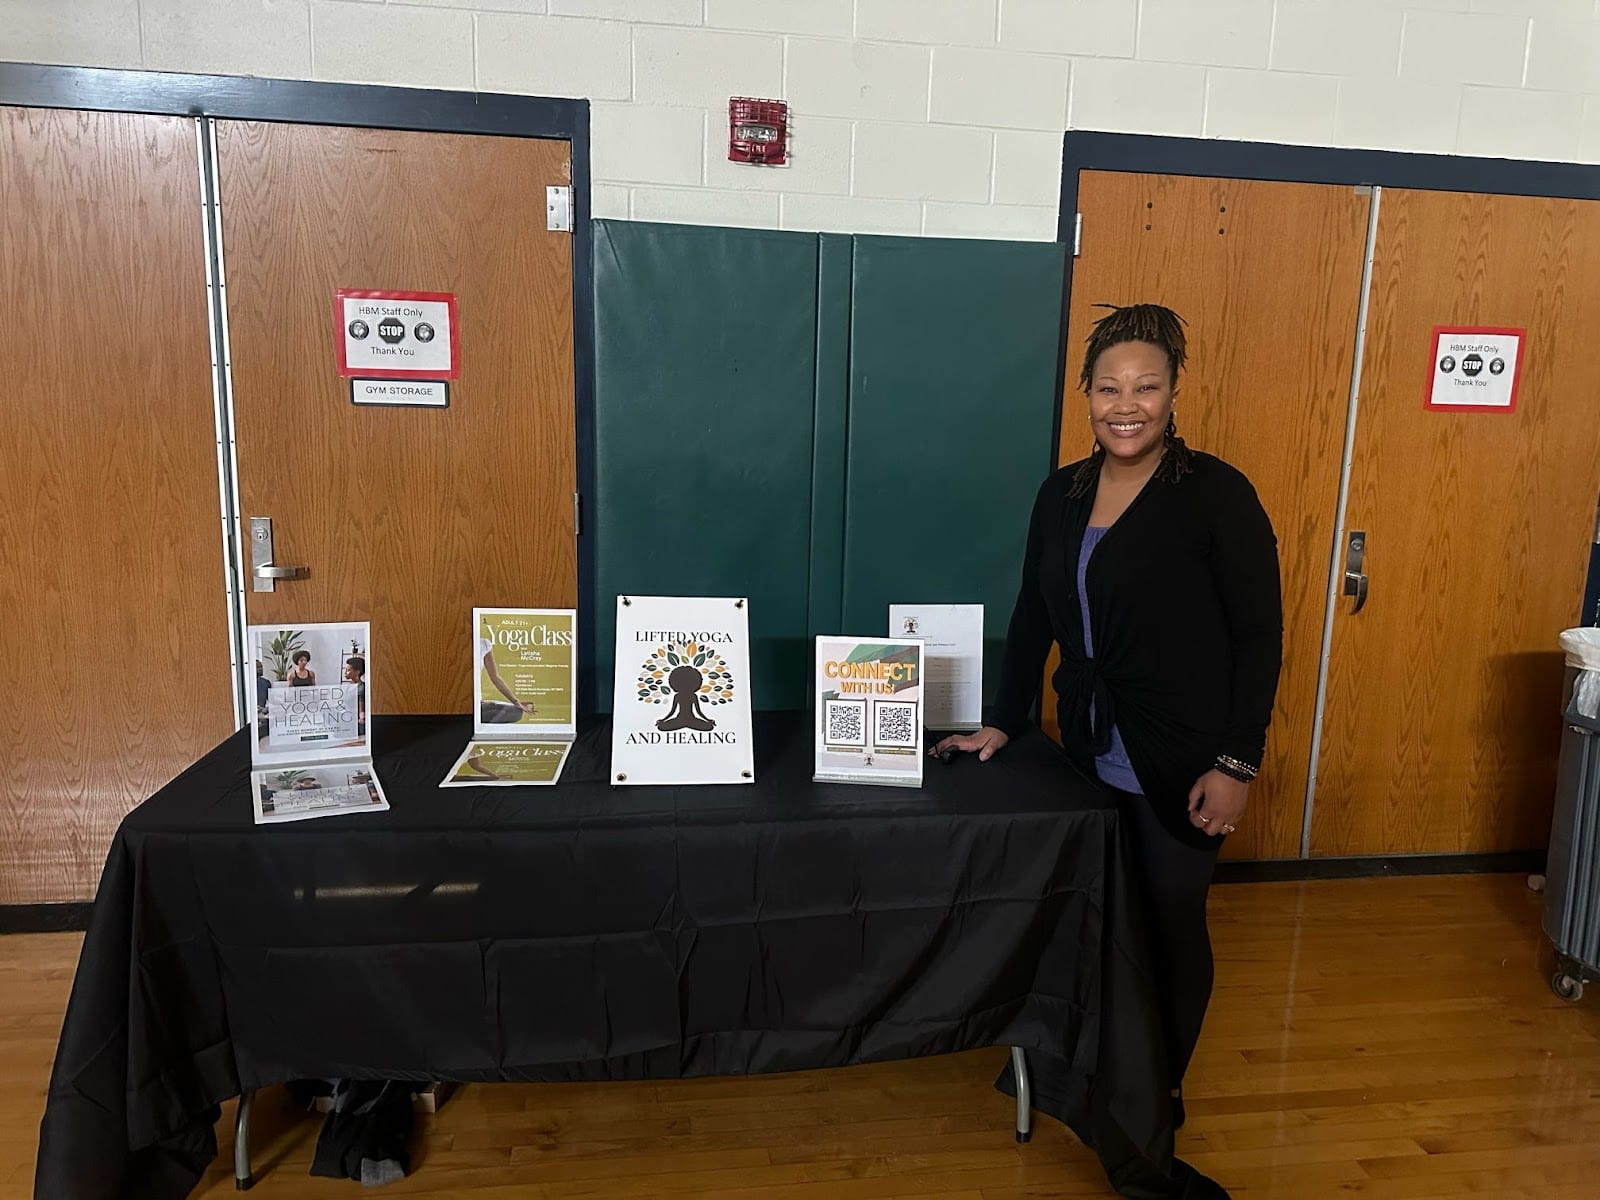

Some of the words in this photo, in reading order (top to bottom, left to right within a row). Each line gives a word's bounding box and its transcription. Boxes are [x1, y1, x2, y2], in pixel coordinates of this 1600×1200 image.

[359, 307, 379, 315] HBM
[381, 308, 401, 316] Staff
[403, 308, 423, 318] Only
[380, 326, 404, 336] STOP
[371, 347, 397, 355] Thank
[399, 348, 415, 356] You
[1484, 346, 1499, 354] Only
[1463, 361, 1481, 369] STOP
[366, 386, 386, 394] GYM
[390, 387, 433, 395] STORAGE
[487, 625, 529, 651] Yoga
[531, 625, 572, 646] Class
[635, 631, 687, 642] LIFTED
[690, 632, 733, 643] YOGA
[824, 660, 915, 681] CONNECT
[841, 681, 872, 694] WITH
[284, 688, 344, 702] LIFTED
[280, 701, 332, 714] YOGA
[336, 700, 346, 711] &
[274, 711, 353, 728] HEALING
[626, 732, 661, 744] AND
[666, 732, 736, 744] HEALING
